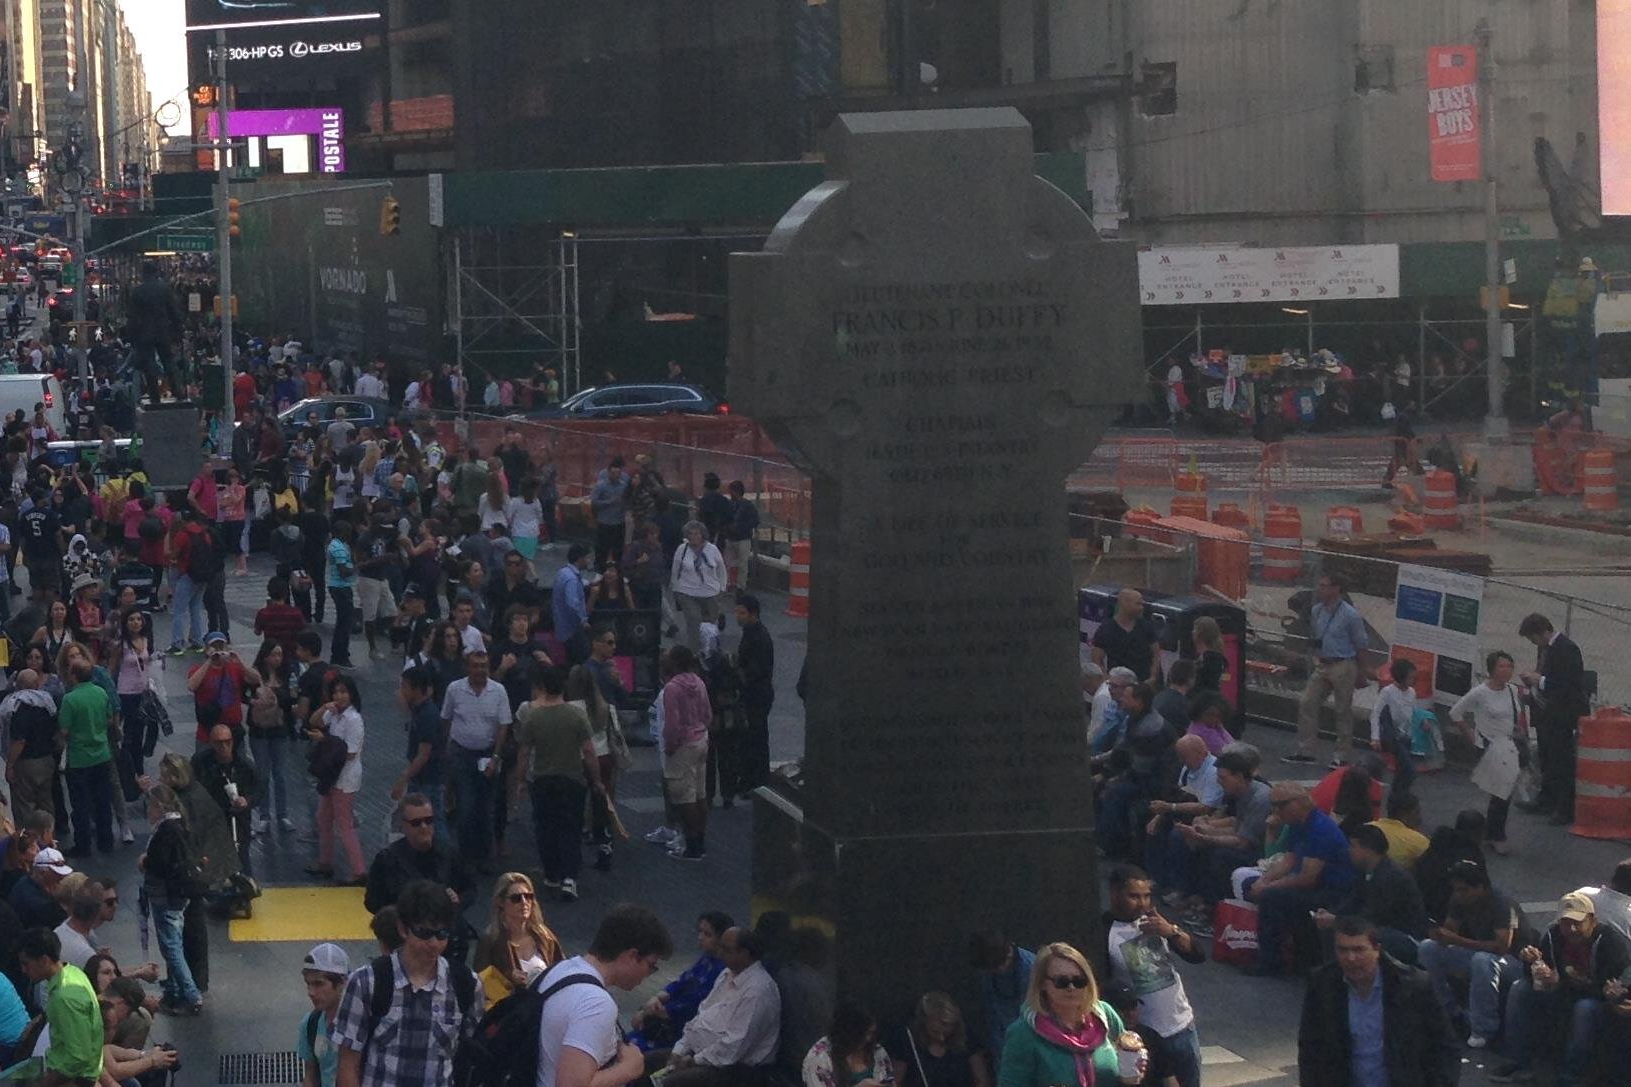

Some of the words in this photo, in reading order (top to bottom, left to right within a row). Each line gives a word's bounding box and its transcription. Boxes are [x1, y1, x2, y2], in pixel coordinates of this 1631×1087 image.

[310, 42, 362, 53] LEXUS
[1428, 84, 1477, 113] JERSEY
[1436, 109, 1474, 136] BOYS
[322, 112, 340, 173] POSTALE
[832, 311, 940, 335] FRANCIS
[976, 304, 1068, 329] DUFFY
[31, 520, 42, 537] 5
